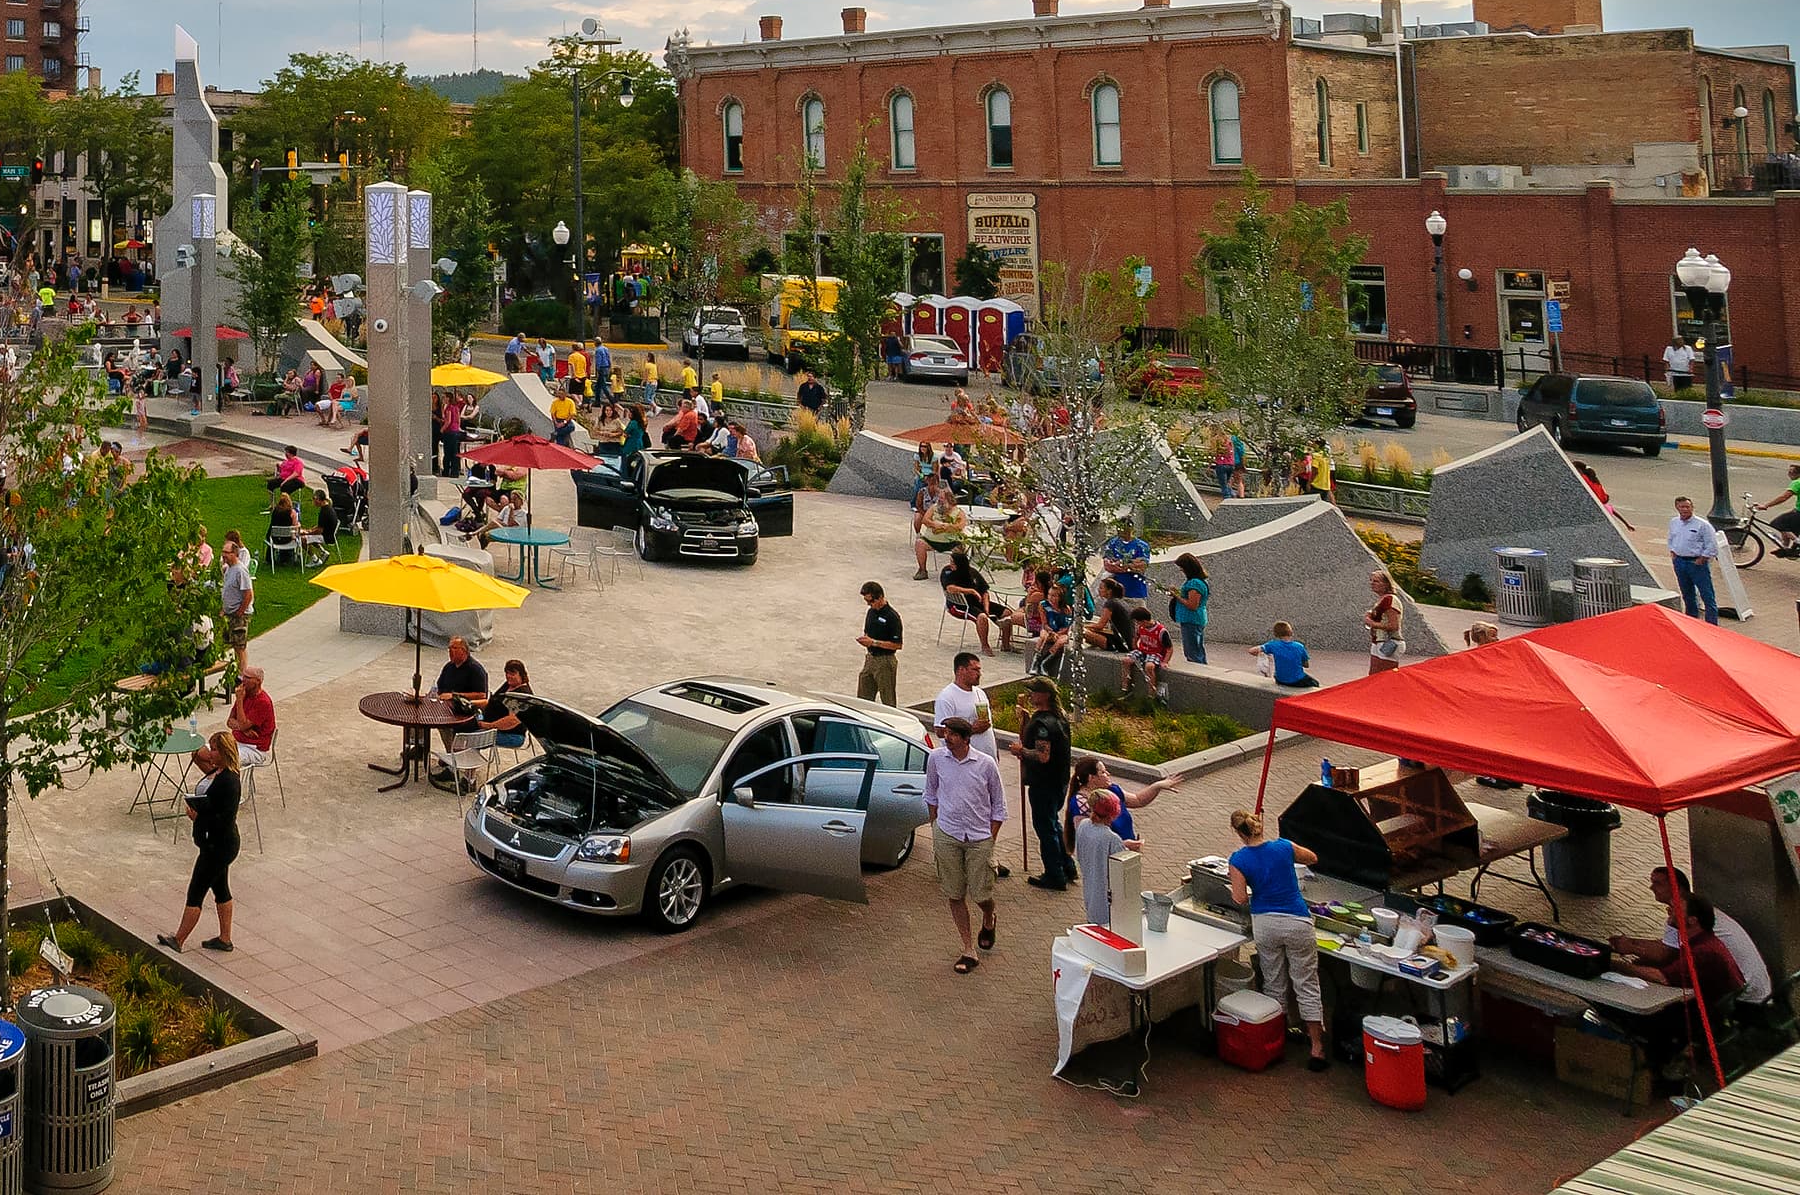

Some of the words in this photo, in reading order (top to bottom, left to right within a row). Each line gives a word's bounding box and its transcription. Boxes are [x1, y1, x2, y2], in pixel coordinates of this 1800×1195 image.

[974, 215, 1029, 228] BUFFALO
[974, 235, 1031, 245] BEADWORK
[28, 988, 69, 1008] TRASH
[62, 1004, 104, 1025] TRASH
[88, 1076, 109, 1091] TRASH
[90, 1086, 107, 1099] ONLY
